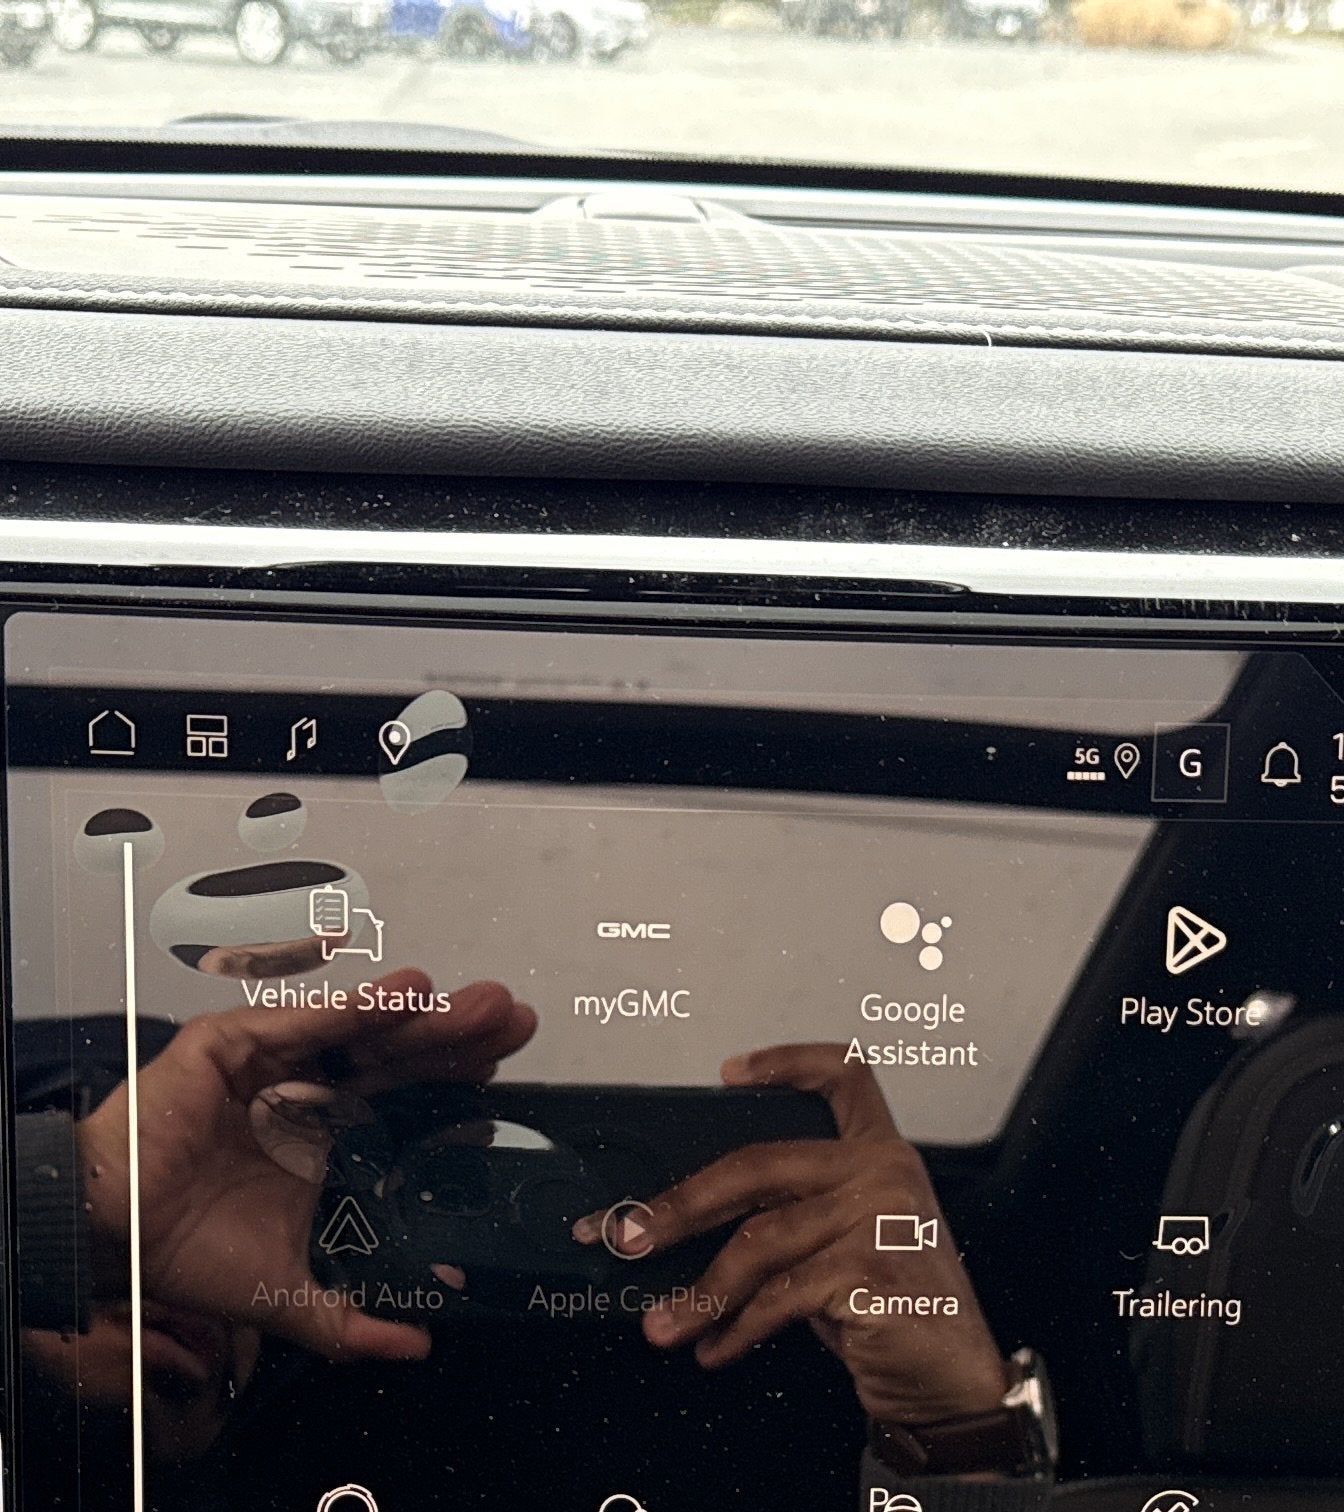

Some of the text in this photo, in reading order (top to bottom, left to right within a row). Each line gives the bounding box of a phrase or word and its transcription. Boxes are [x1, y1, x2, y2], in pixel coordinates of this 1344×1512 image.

[1073, 748, 1101, 766] 5G
[1178, 749, 1203, 777] G
[596, 921, 671, 939] GMC
[241, 979, 452, 1013] Vehicle Status
[573, 989, 691, 1025] myGMC
[860, 993, 966, 1030] Google
[1121, 998, 1262, 1033] Play Store
[843, 1037, 979, 1067] Assistant
[251, 1280, 445, 1311] Android Auto
[528, 1285, 729, 1320] Apple CarPlay
[848, 1287, 960, 1316] Camera
[1113, 1290, 1243, 1325] Trailering
